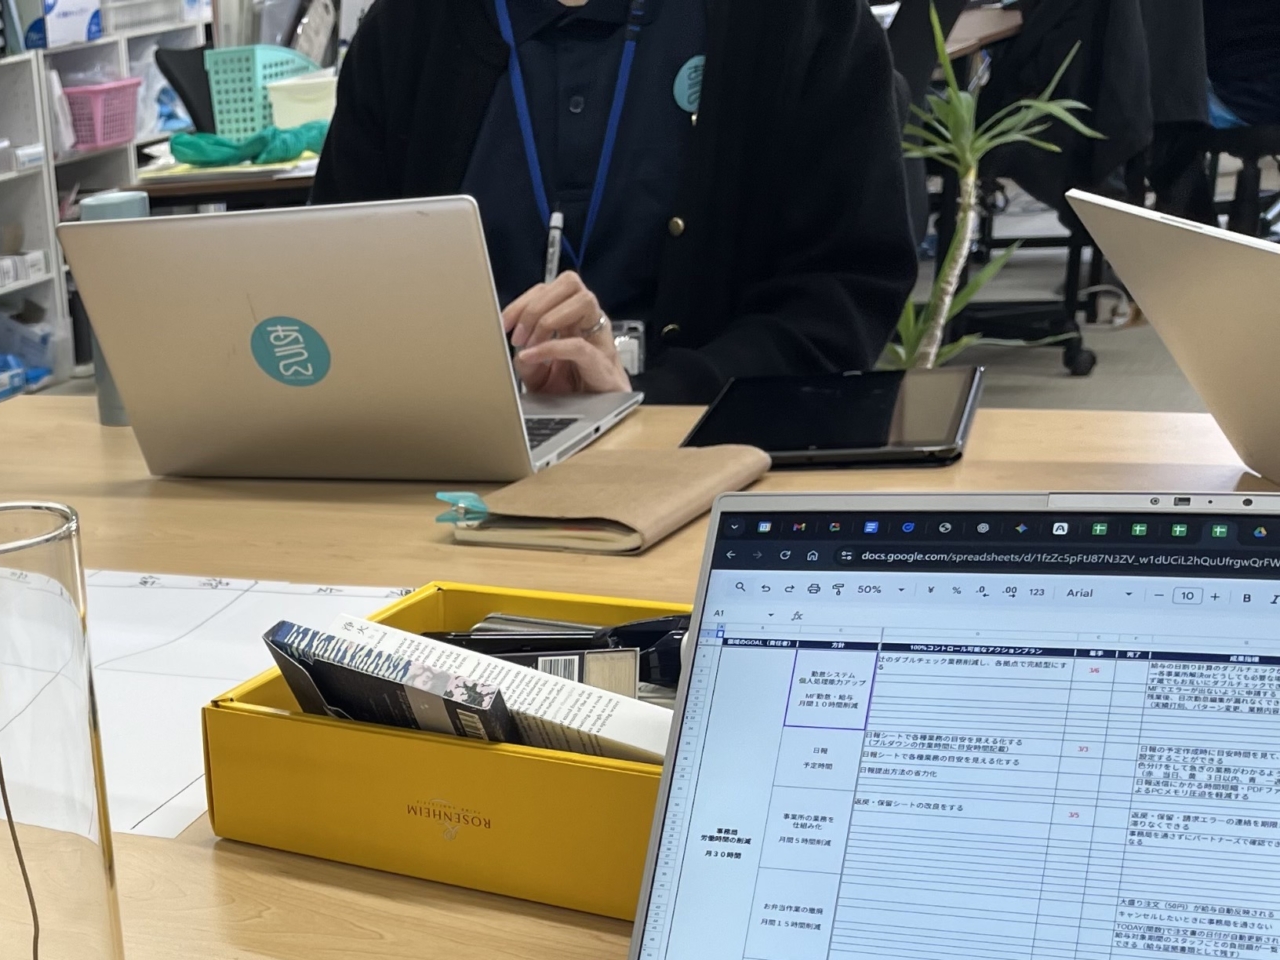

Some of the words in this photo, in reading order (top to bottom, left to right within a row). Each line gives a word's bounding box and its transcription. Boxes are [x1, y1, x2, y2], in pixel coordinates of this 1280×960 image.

[857, 585, 882, 594] 50%
[1029, 588, 1045, 596] 123
[1067, 588, 1094, 598] Arial
[1181, 592, 1195, 601] 10
[713, 609, 725, 617] A1
[813, 747, 828, 755] 日報
[802, 762, 833, 771] 予定時間
[406, 804, 491, 829] ROSENHEIM
[792, 821, 823, 830] 仕組み化
